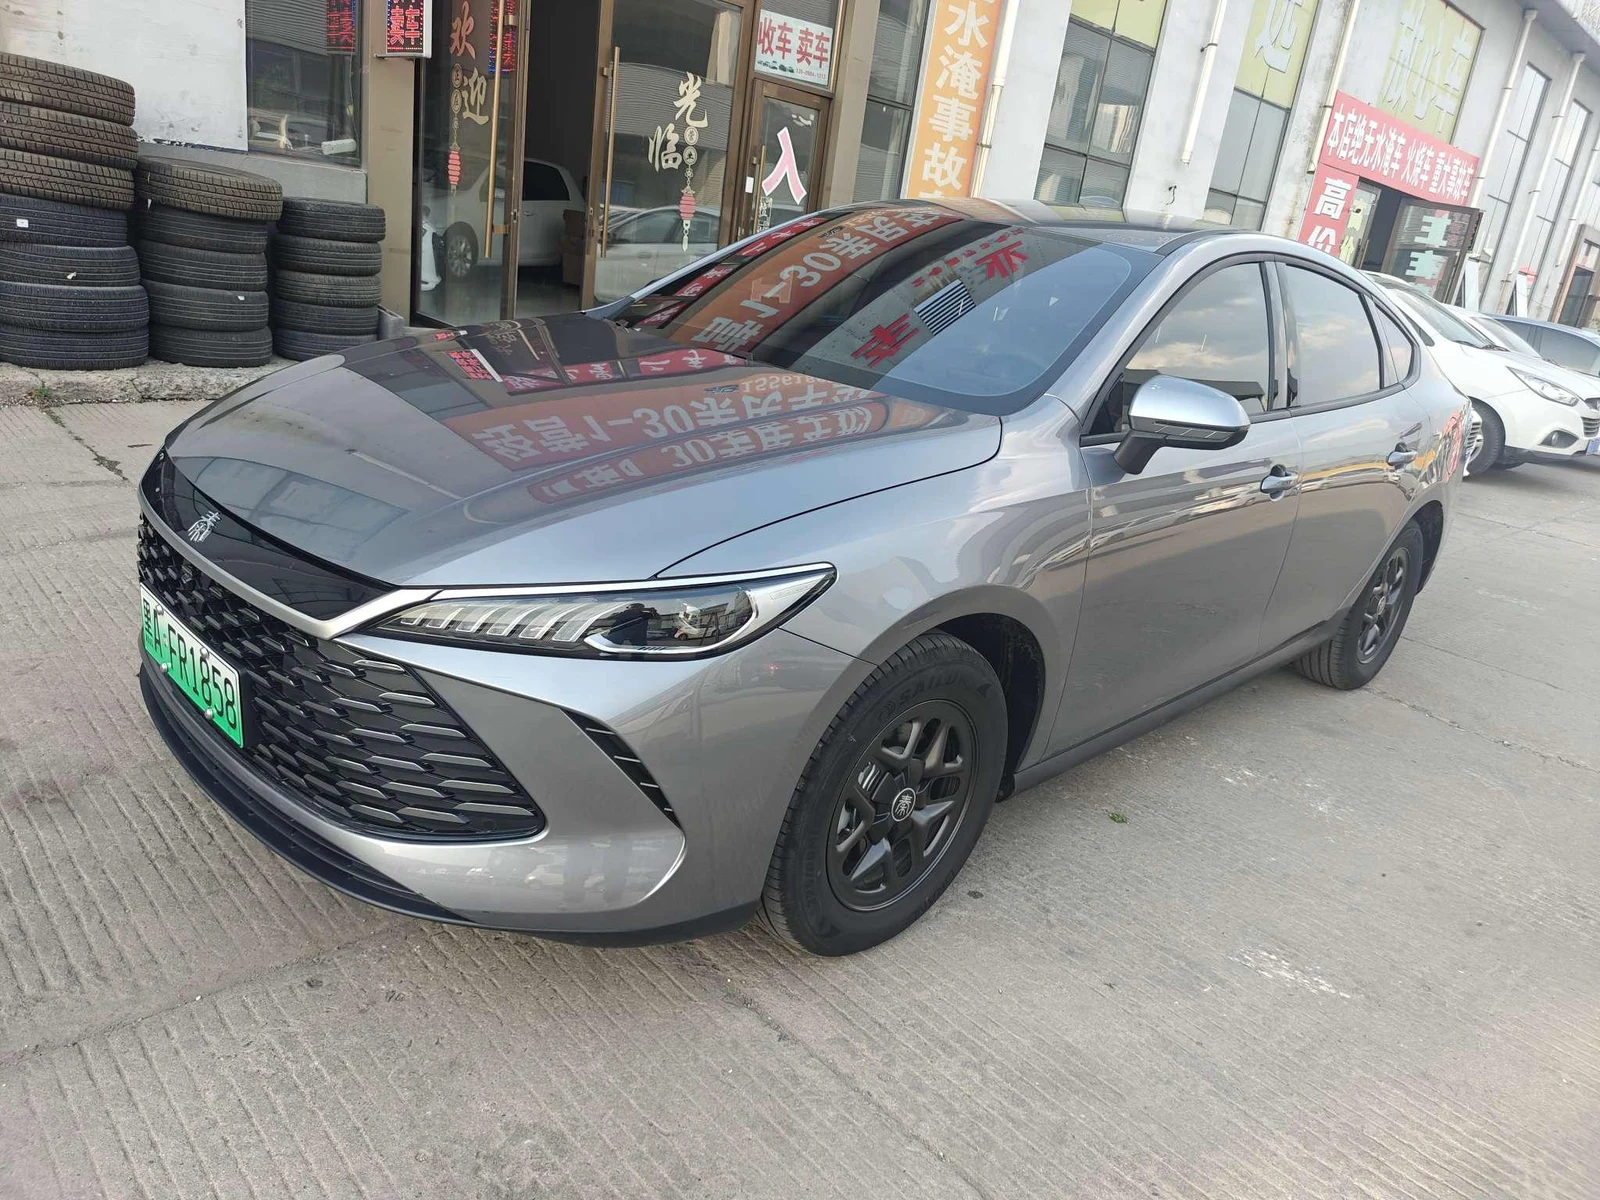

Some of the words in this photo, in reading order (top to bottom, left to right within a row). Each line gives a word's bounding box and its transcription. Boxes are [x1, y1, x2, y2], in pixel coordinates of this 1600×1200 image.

[450, 1, 490, 125] 欢迎
[758, 17, 793, 60] 收车
[797, 27, 830, 69] 卖车
[648, 71, 709, 172] 光临
[918, 0, 995, 198] 水淹事故
[762, 126, 807, 205] 入
